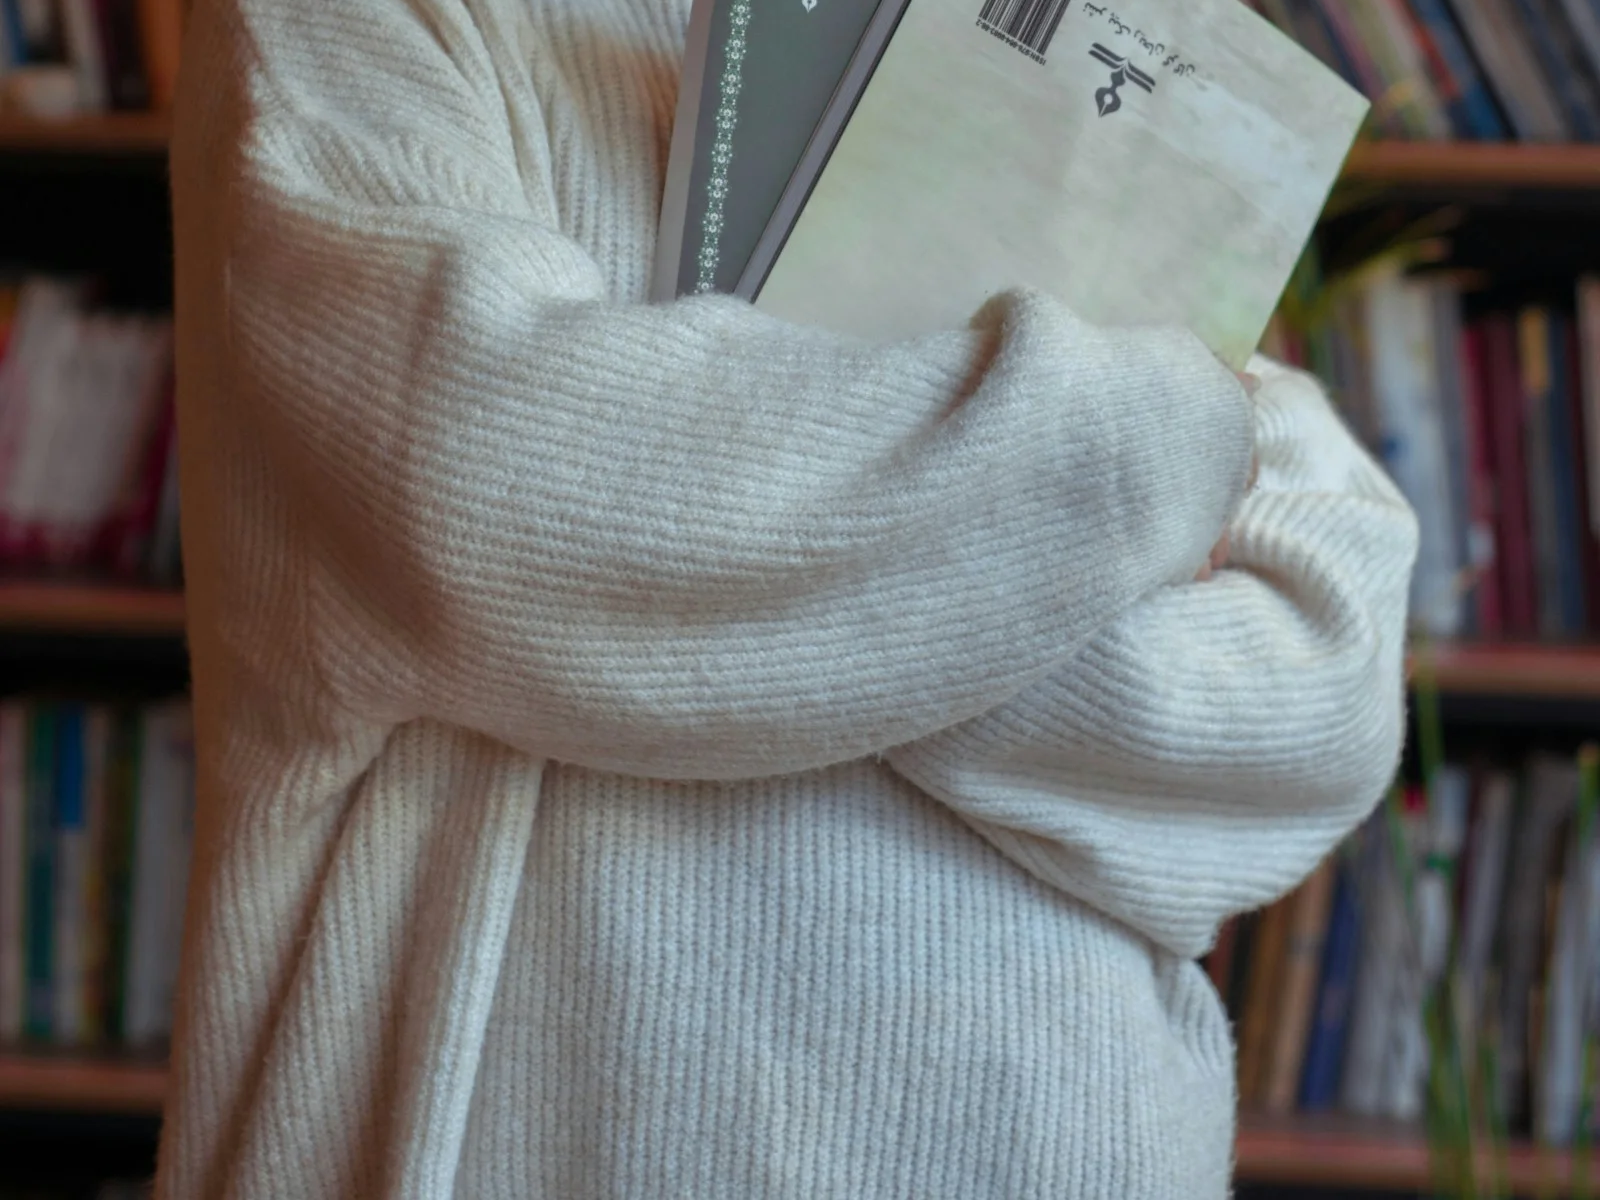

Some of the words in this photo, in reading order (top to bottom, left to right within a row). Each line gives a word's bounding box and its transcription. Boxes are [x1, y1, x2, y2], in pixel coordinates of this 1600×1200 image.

[1082, 2, 1107, 17] نشر
[1108, 12, 1131, 35] پیک
[1133, 29, 1165, 55] ریحان
